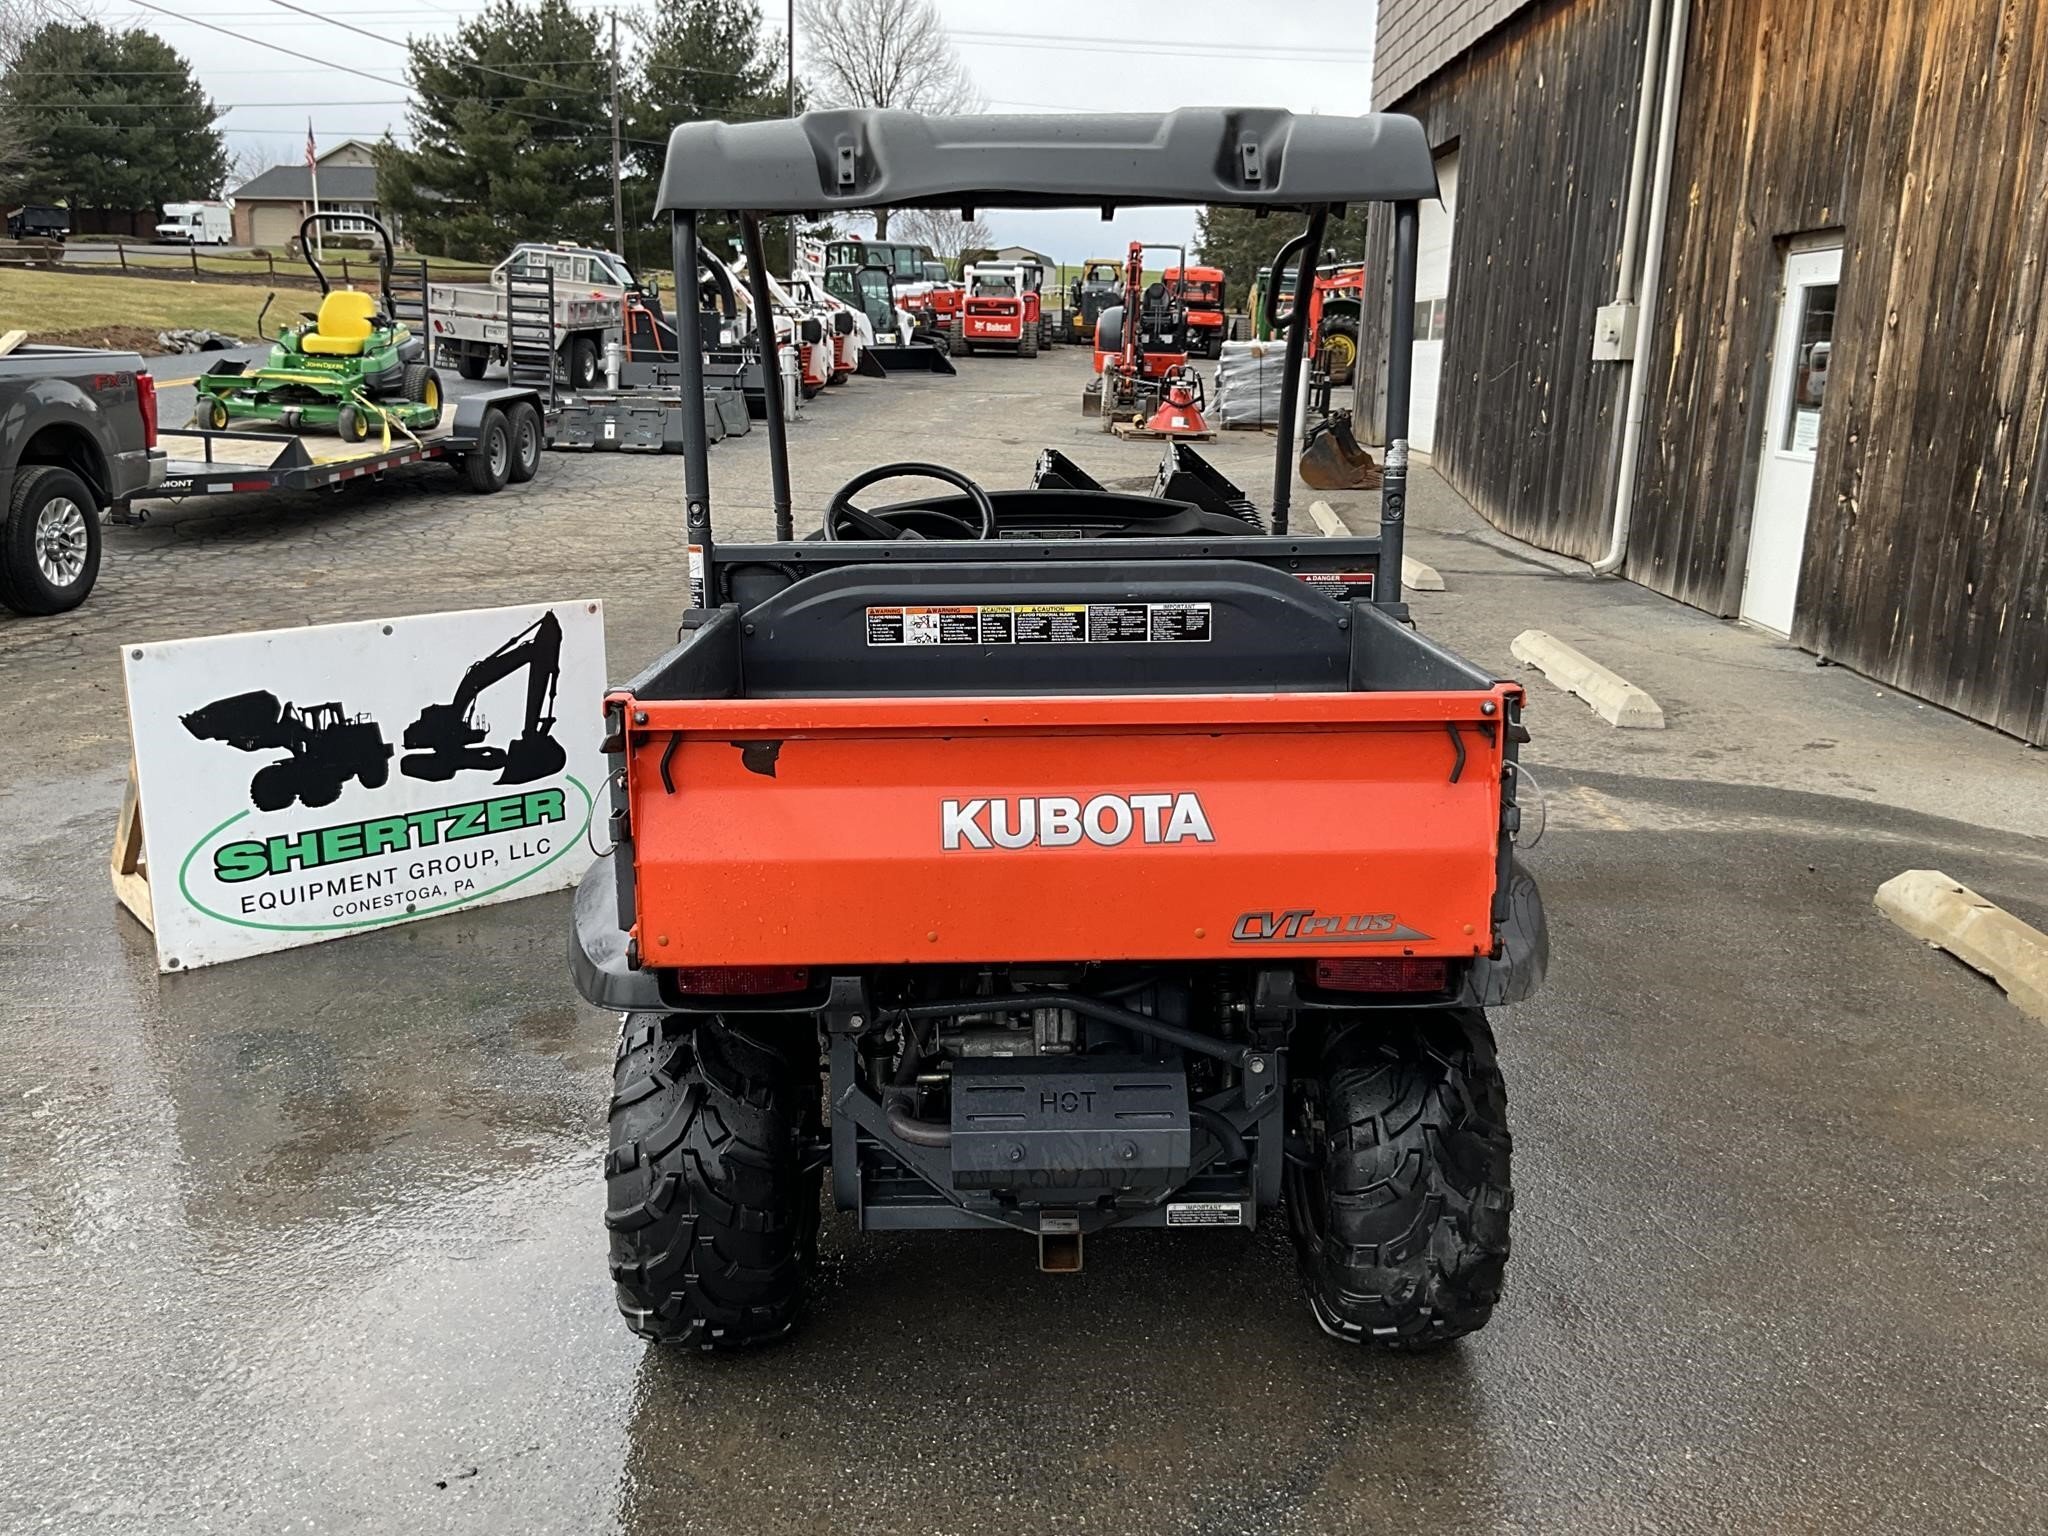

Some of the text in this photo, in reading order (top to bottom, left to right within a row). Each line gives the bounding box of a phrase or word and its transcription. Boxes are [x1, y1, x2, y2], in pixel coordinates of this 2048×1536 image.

[986, 322, 1011, 331] Bobcat
[213, 787, 566, 884] SHERTZER
[942, 792, 1216, 851] KUBOTA
[240, 837, 552, 914] EQUIPMENT GROUP, LLC
[332, 878, 476, 918] CONESTOGA, PA
[1040, 1090, 1097, 1114] HOT
